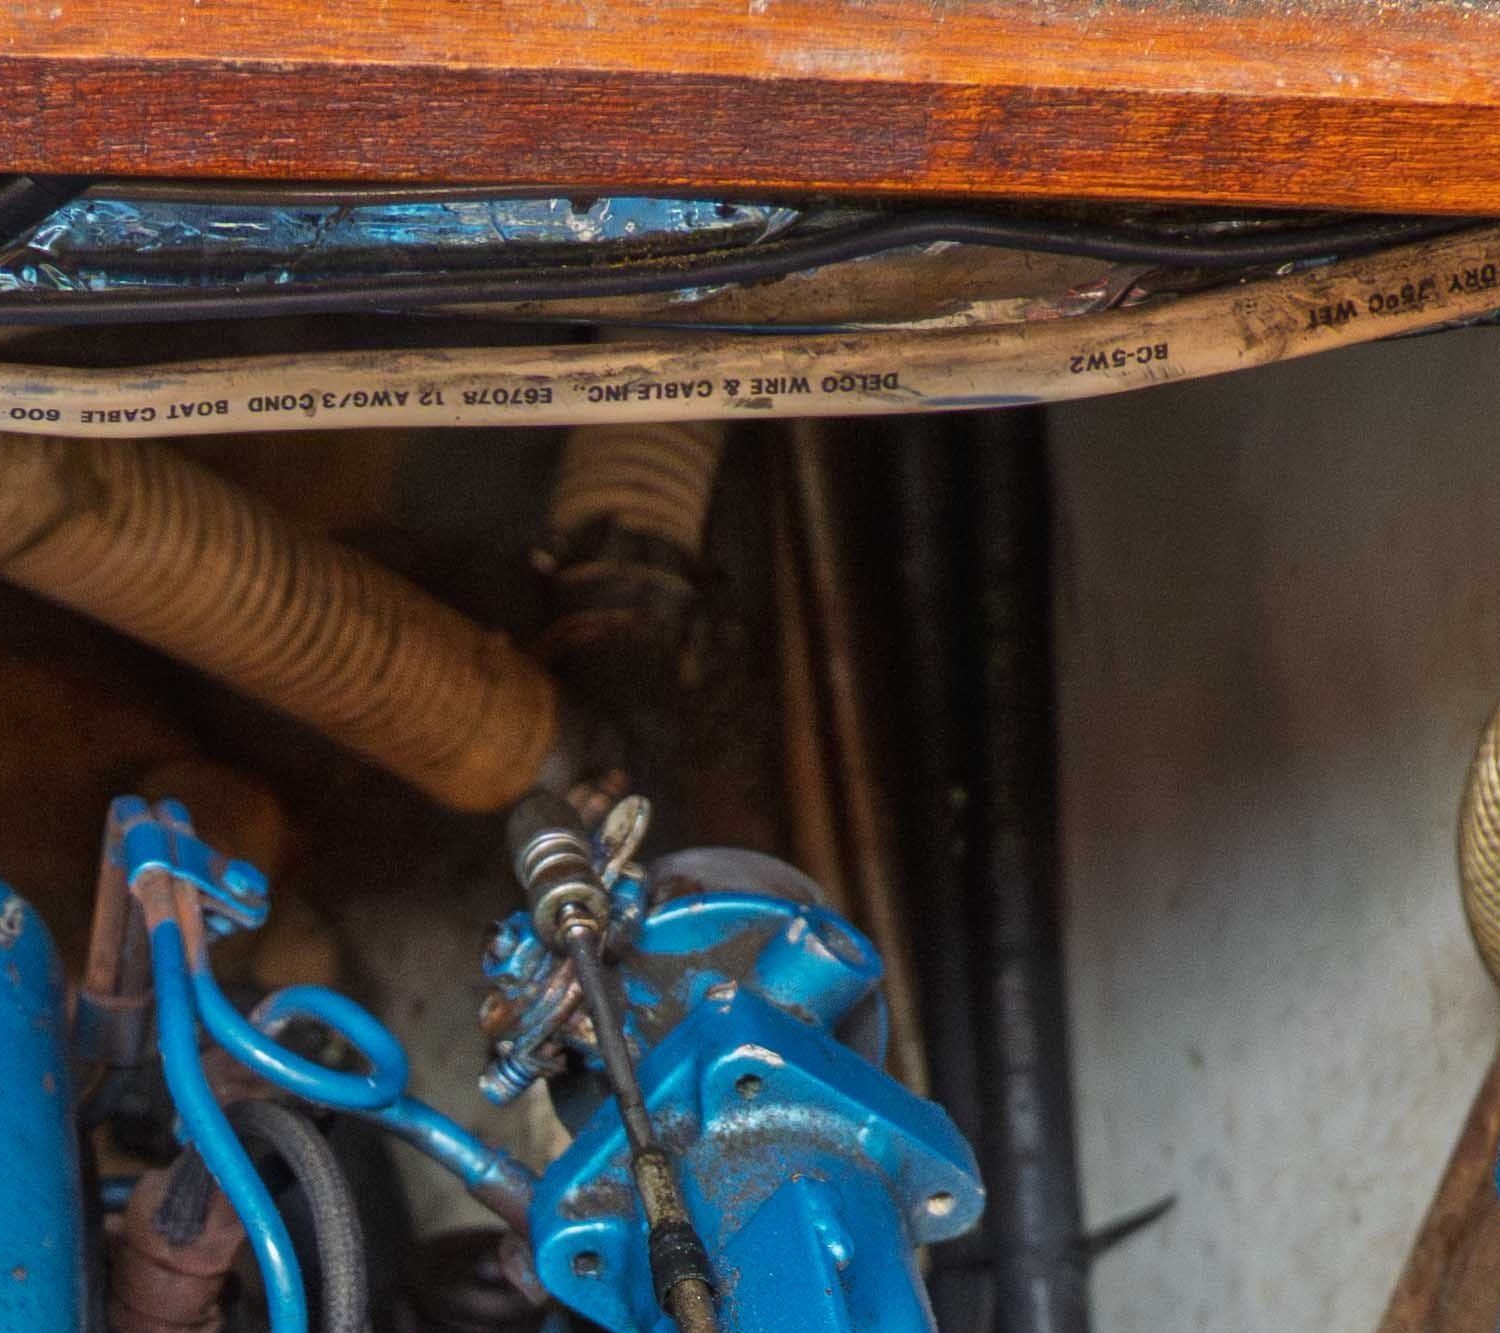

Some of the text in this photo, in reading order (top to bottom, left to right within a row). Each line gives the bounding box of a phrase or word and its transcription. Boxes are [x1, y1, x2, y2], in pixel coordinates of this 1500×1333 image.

[1069, 343, 1169, 374] BC-5W2
[637, 380, 712, 400] CABLE
[723, 378, 740, 396] &
[750, 376, 811, 395] WIRE
[822, 373, 899, 393] DELCO
[248, 393, 314, 412] COND
[322, 389, 410, 408] AWG/3
[420, 389, 445, 405] 12
[463, 387, 552, 405] E67078
[9, 407, 61, 421] 600
[81, 407, 156, 423] CABLE
[167, 399, 229, 419] BOAT
